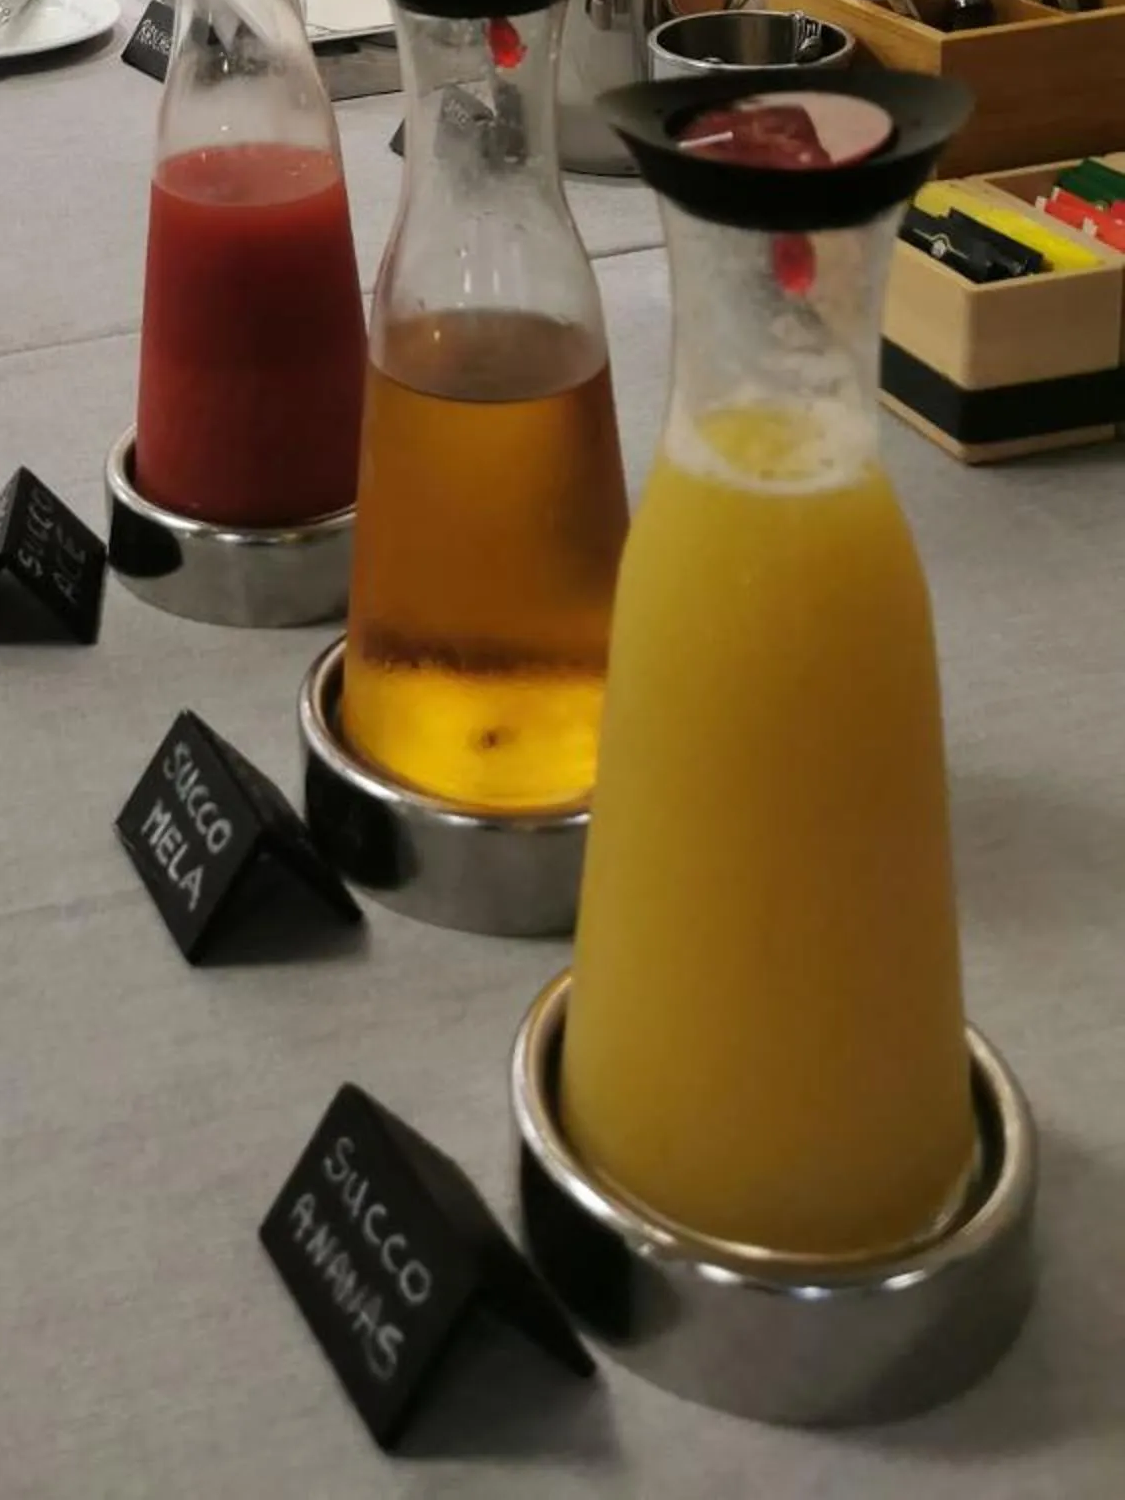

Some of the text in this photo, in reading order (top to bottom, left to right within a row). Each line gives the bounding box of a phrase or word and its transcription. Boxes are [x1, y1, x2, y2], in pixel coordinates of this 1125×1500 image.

[140, 797, 205, 912] MELA
[162, 741, 233, 854] SUCCO
[290, 1192, 405, 1381] ANANAS
[323, 1136, 433, 1305] SUCCO
